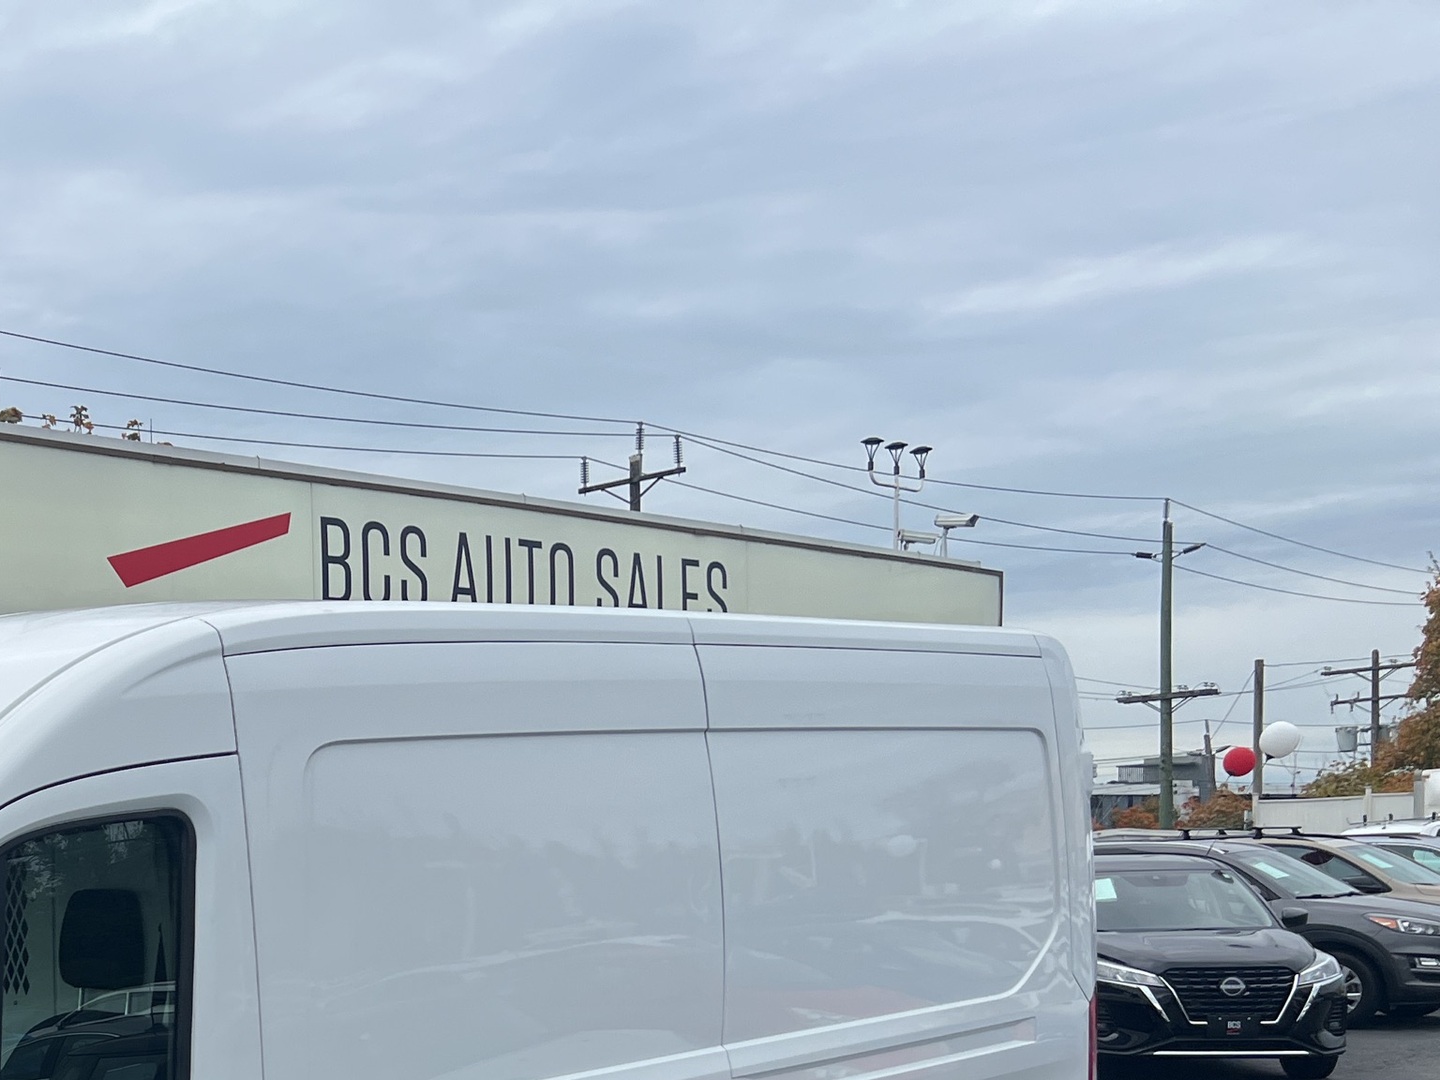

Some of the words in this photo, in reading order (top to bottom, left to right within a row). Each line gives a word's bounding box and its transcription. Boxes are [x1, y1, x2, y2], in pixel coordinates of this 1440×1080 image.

[320, 516, 428, 601] BCS
[451, 532, 574, 605] AUTO
[596, 548, 728, 613] SALES
